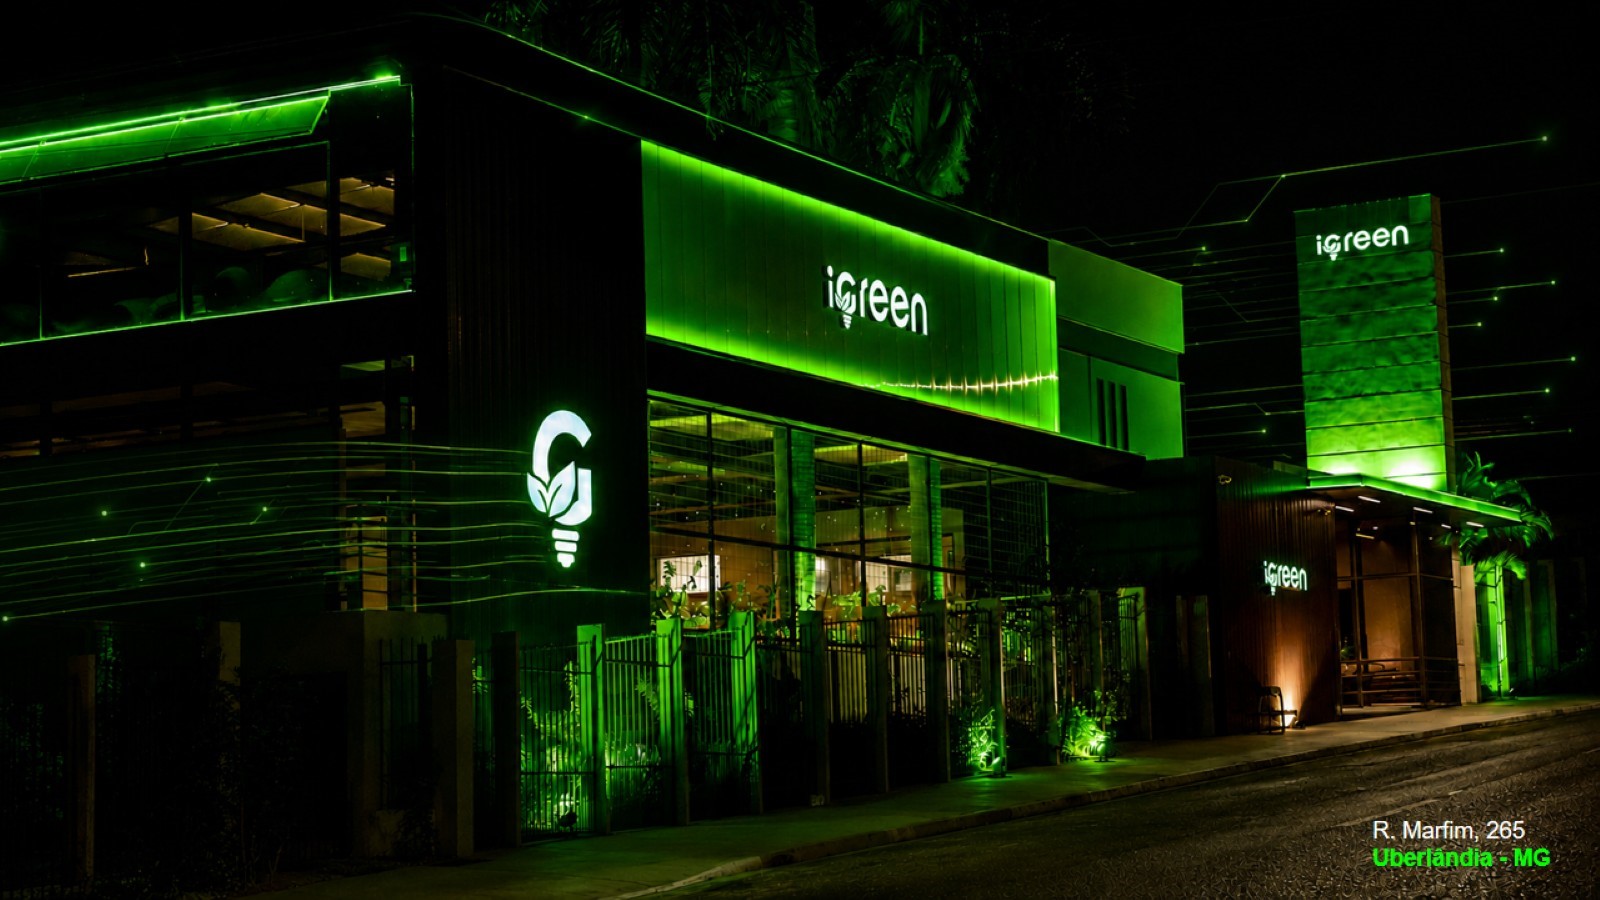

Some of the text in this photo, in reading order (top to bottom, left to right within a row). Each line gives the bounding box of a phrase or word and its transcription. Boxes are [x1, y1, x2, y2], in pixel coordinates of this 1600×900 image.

[1315, 225, 1410, 261] iGreen
[826, 265, 928, 336] iGreen
[1263, 560, 1308, 596] iGreen
